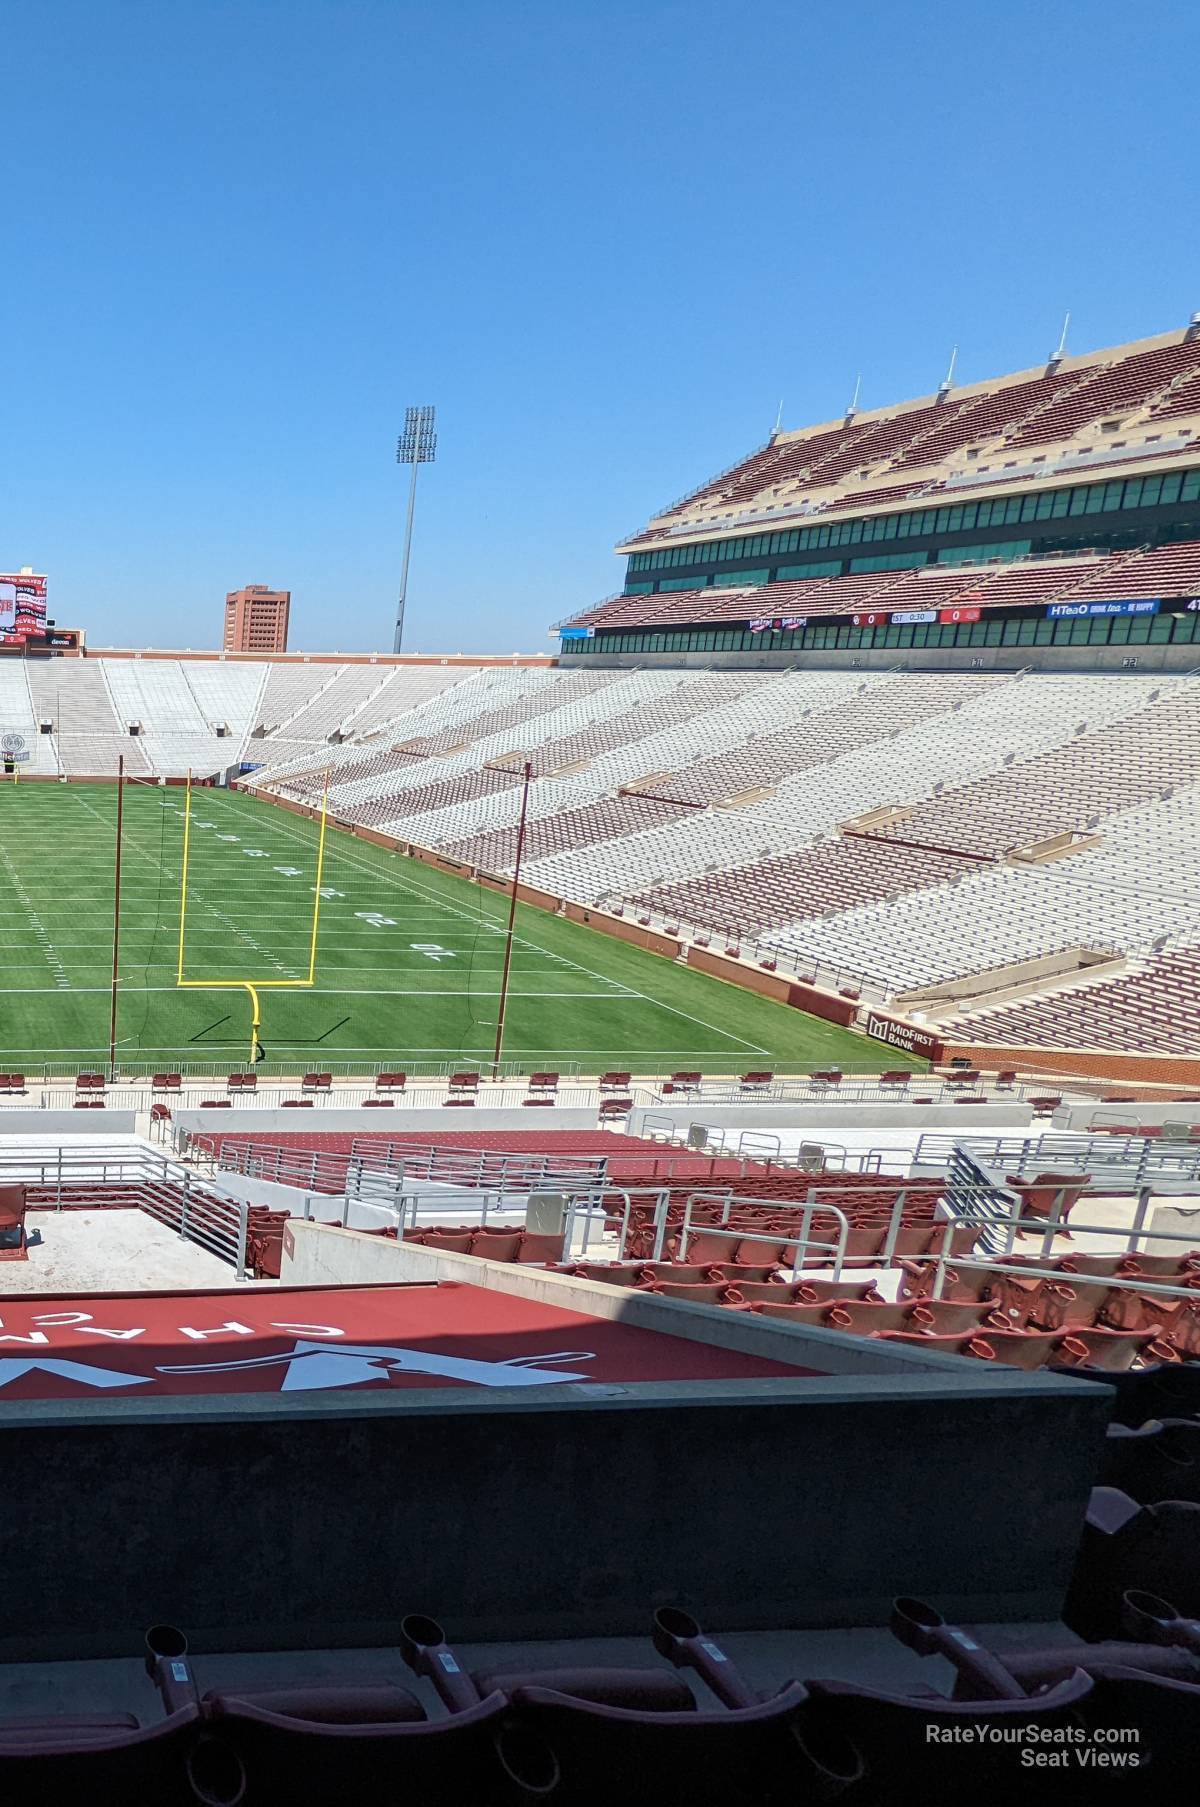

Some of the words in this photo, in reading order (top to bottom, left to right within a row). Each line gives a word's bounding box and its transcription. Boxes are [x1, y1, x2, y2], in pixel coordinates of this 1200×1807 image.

[952, 610, 960, 620] 0
[1051, 604, 1088, 616] HTeaO
[868, 614, 875, 624] 0
[51, 638, 70, 646] devon
[354, 912, 398, 924] 20
[409, 943, 456, 957] 10
